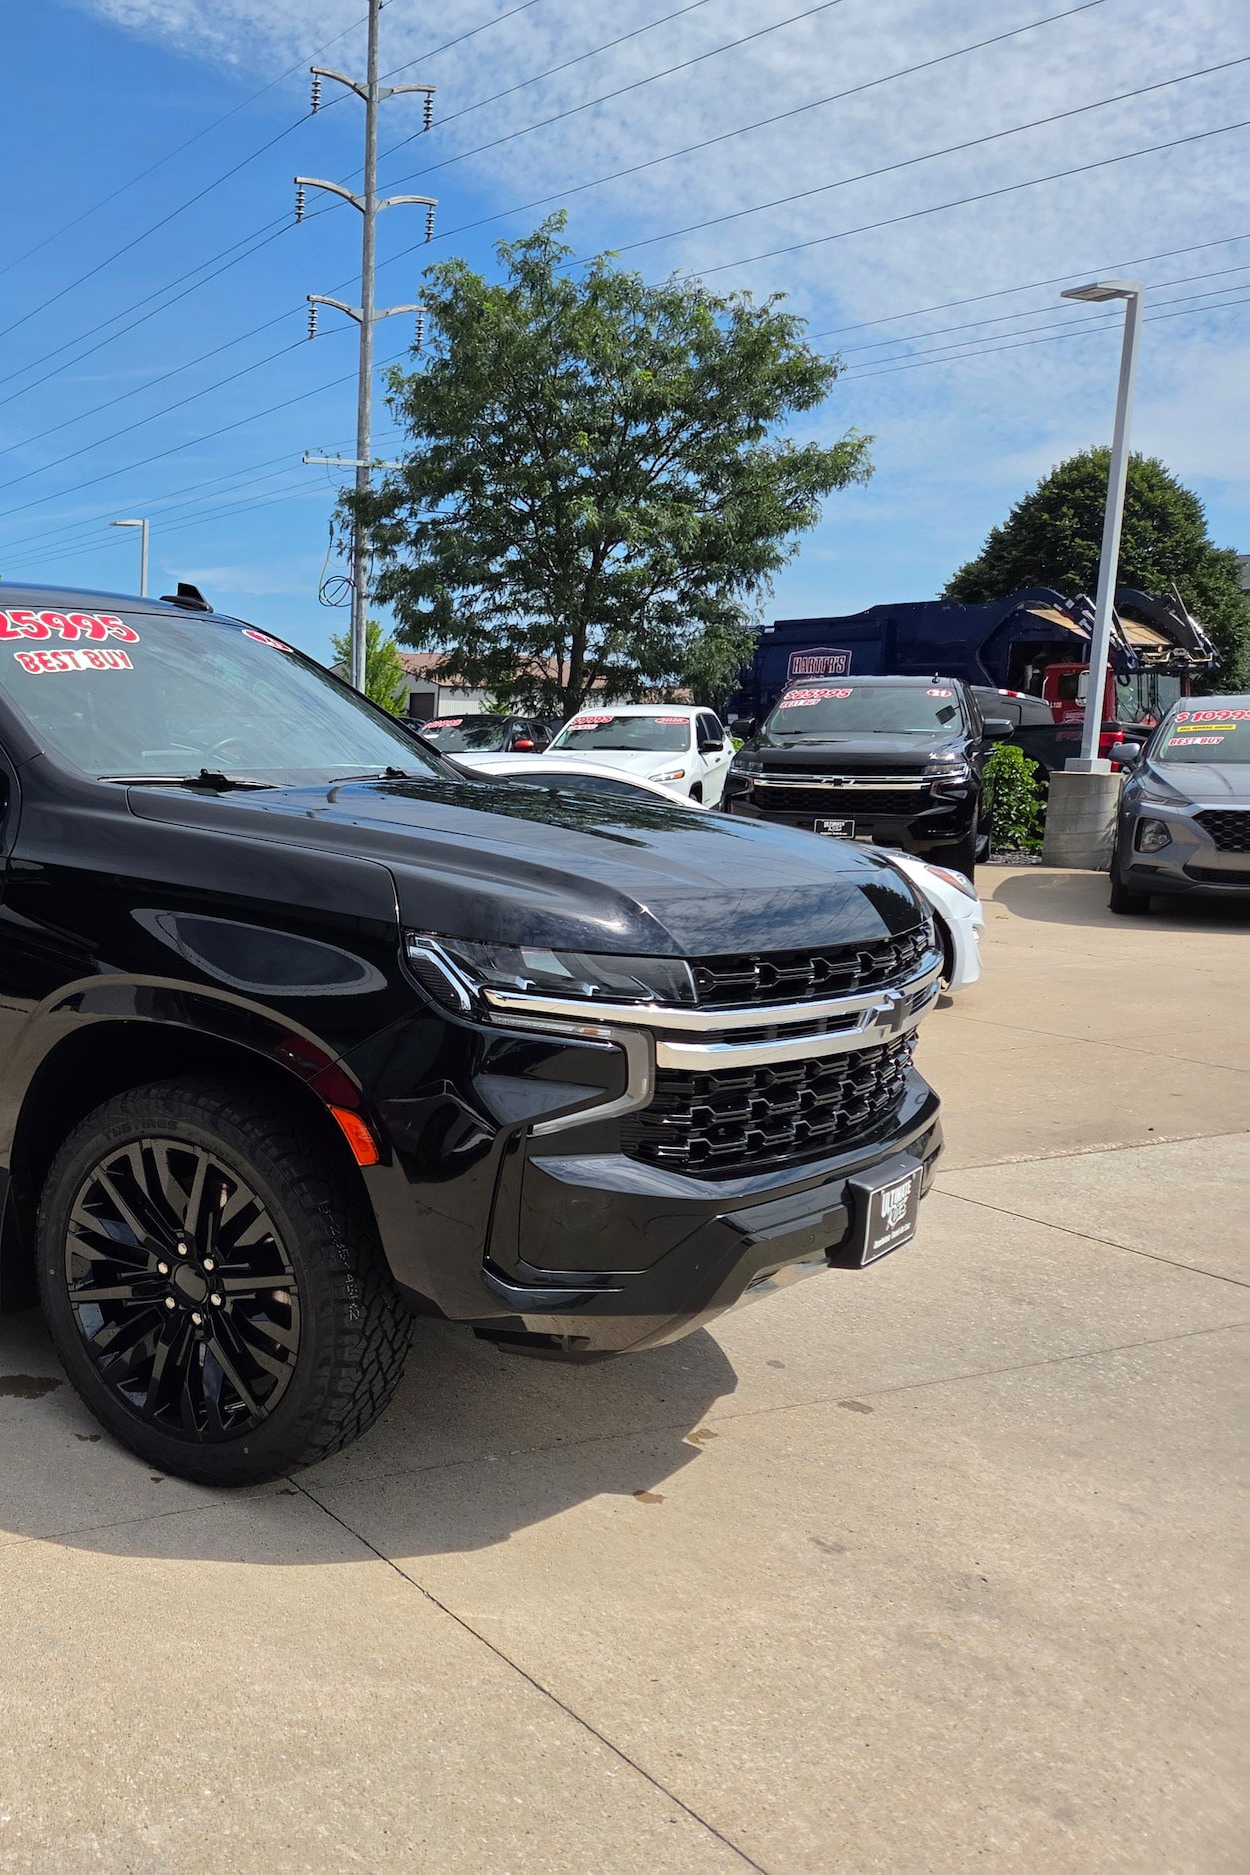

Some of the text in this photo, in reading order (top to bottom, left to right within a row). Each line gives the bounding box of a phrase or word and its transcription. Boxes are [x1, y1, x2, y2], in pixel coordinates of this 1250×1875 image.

[14, 650, 134, 674] BEST BUY
[1169, 736, 1224, 746] BEST BUY
